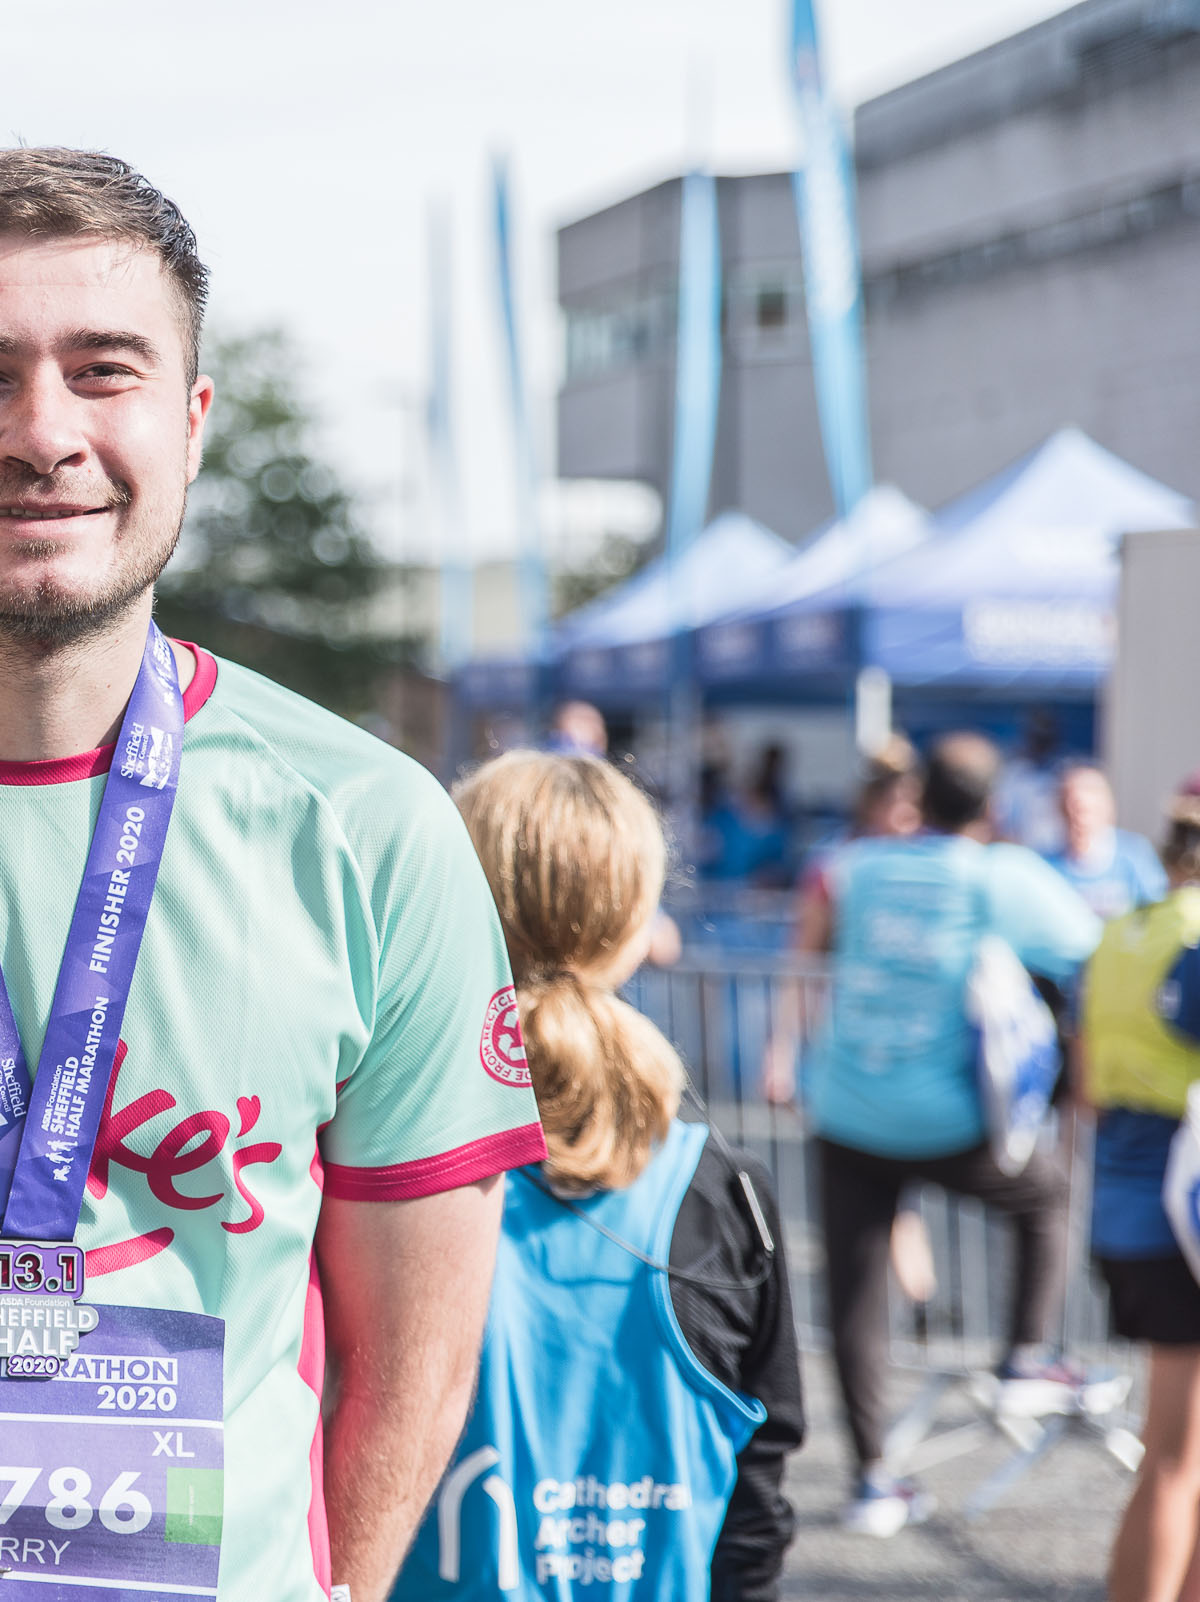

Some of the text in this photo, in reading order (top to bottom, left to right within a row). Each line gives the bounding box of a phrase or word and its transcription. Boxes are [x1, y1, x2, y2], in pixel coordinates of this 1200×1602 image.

[120, 722, 145, 779] Sheffield
[88, 806, 145, 974] FINISHER 2020
[1, 1057, 27, 1118] Sheffield
[47, 1064, 63, 1107] Foundation
[64, 995, 110, 1139] HALF MARATHON
[50, 1056, 79, 1135] SHEFFIELD
[0, 1297, 70, 1307] ASDA Foundation
[10, 1357, 58, 1374] 2020
[97, 1386, 178, 1412] 2020
[152, 1431, 195, 1458] XL
[533, 1474, 691, 1514] Cathedra
[534, 1511, 646, 1551] Archer
